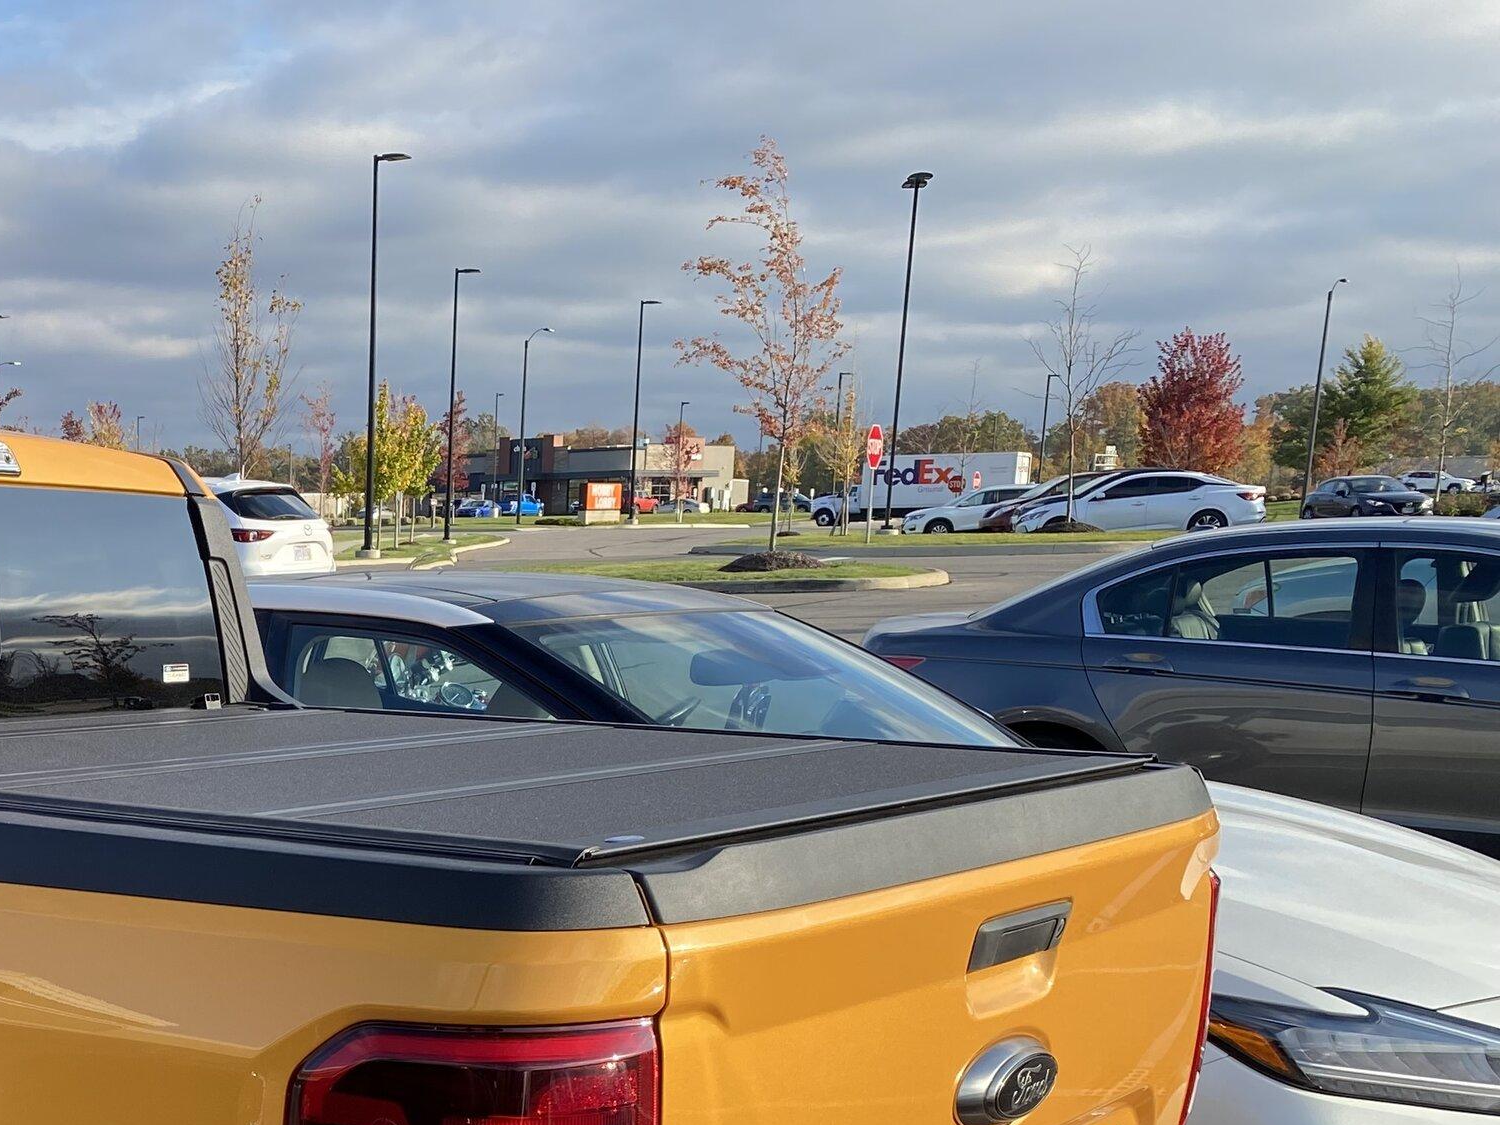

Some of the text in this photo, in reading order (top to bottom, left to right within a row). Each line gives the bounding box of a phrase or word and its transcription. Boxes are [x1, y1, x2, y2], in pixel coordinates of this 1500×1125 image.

[868, 439, 882, 455] STOP
[873, 459, 953, 486] FedEx
[1011, 1063, 1051, 1111] Ford
